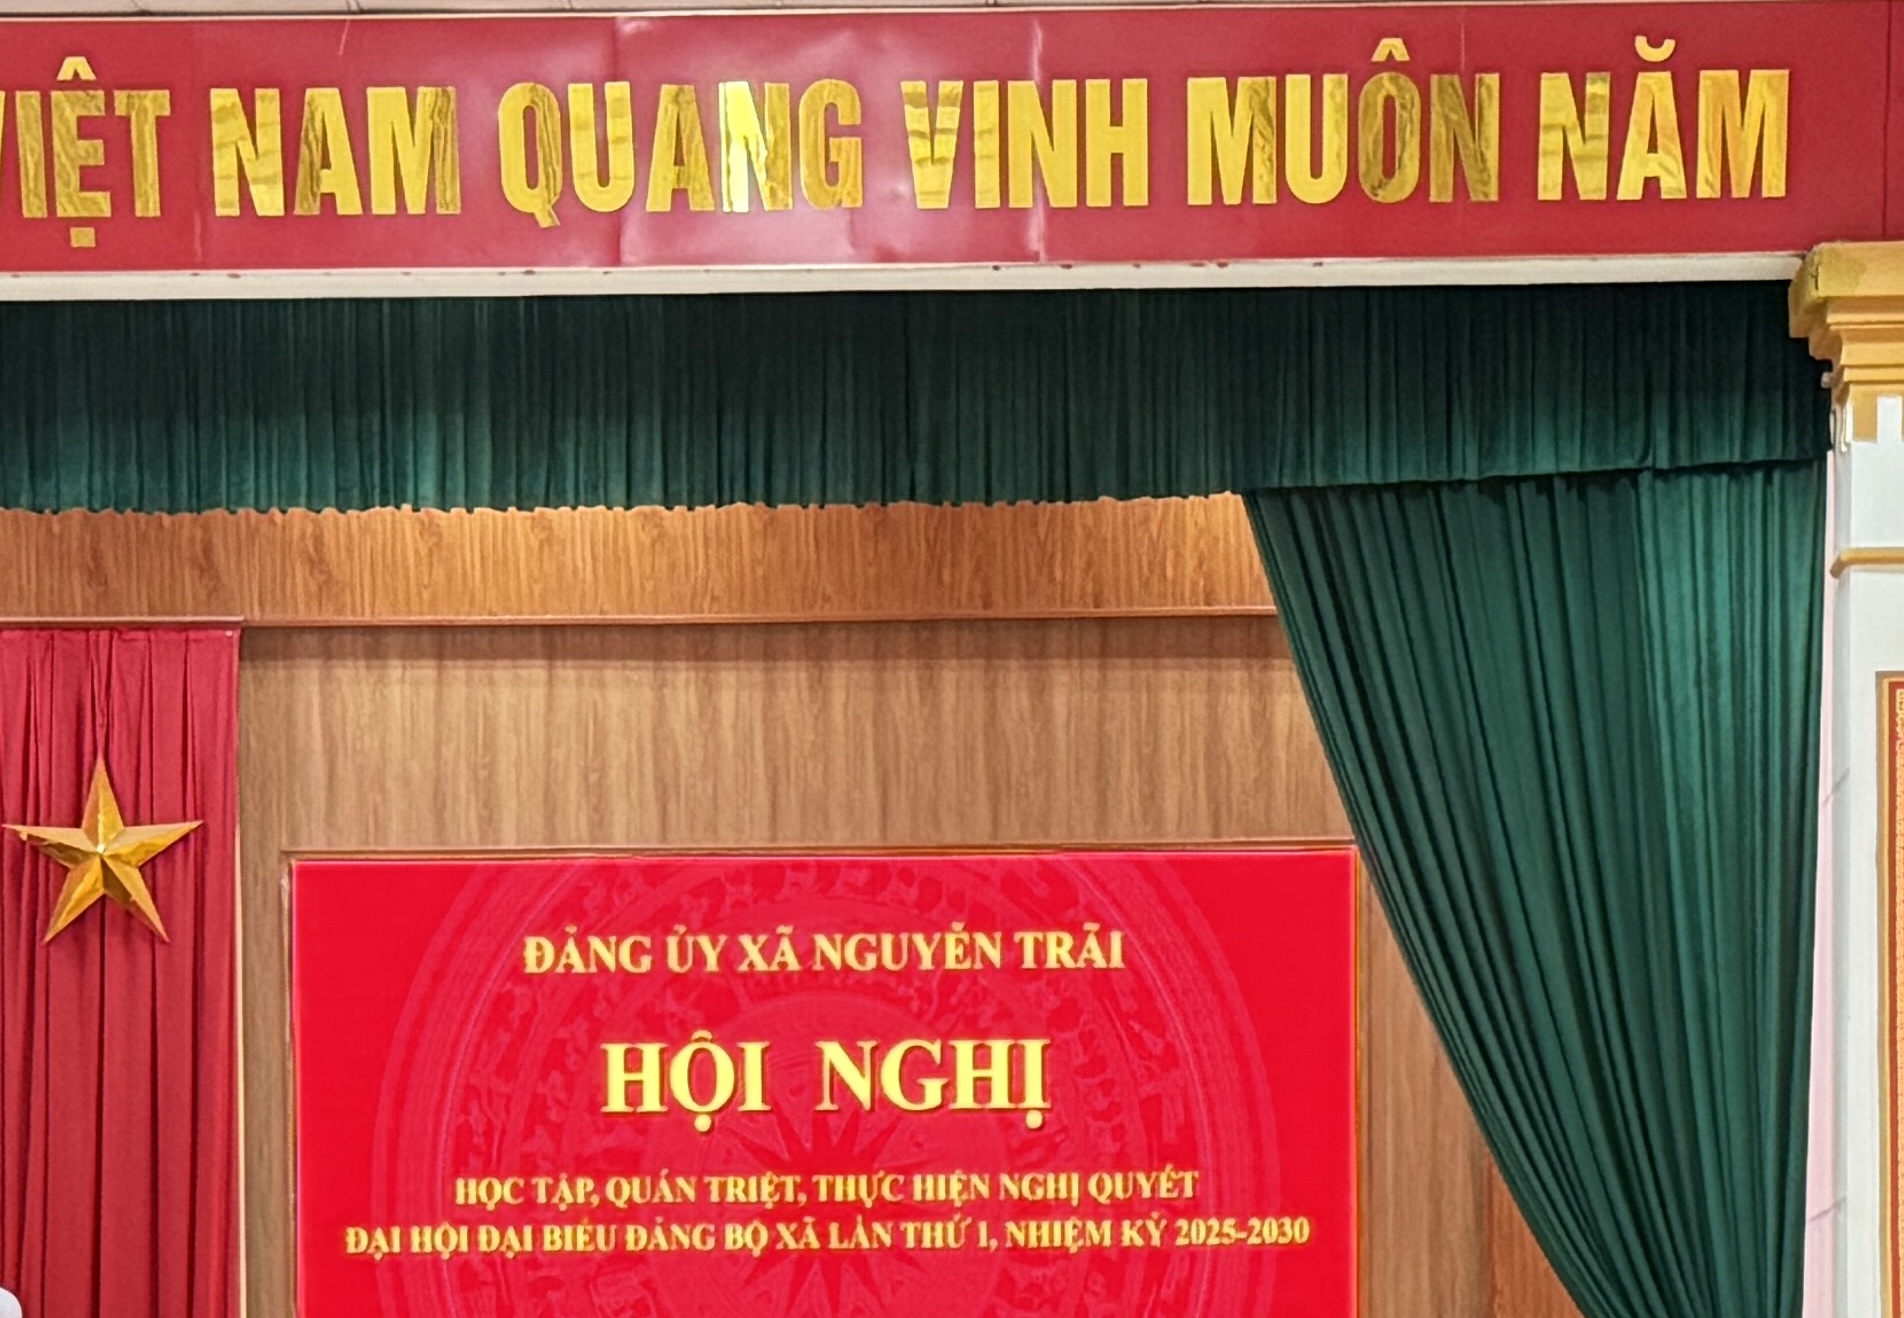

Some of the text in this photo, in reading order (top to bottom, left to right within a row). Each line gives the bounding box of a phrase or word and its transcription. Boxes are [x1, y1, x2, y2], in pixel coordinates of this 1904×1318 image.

[212, 80, 458, 217] NAM
[500, 79, 862, 229] QUANG
[901, 76, 1147, 209] VINH
[1189, 40, 1499, 205] MUÔN
[1539, 37, 1788, 199] NĂM
[524, 922, 1124, 973] ĐẢNG ỦY XÃ NGUYỄN TRÃI
[601, 1030, 1050, 1131] HỘI NGHỊ
[456, 1164, 1199, 1211] HỌC TẬP, QUÁN TRIỆT, THỰC HIỆN NGHỊ QUYẾT
[346, 1226, 401, 1260] ĐẠI
[411, 1222, 468, 1259] HỘI
[478, 1225, 533, 1258] ĐẠI
[543, 1220, 616, 1251] BIỂU
[625, 1217, 715, 1251] ĐẢNG
[725, 1220, 768, 1257] BỘ
[776, 1216, 820, 1249] XÃ
[900, 1214, 972, 1248] THỨ
[1005, 1217, 1112, 1253] NHIỆM
[1175, 1217, 1310, 1245] 2025-2030
